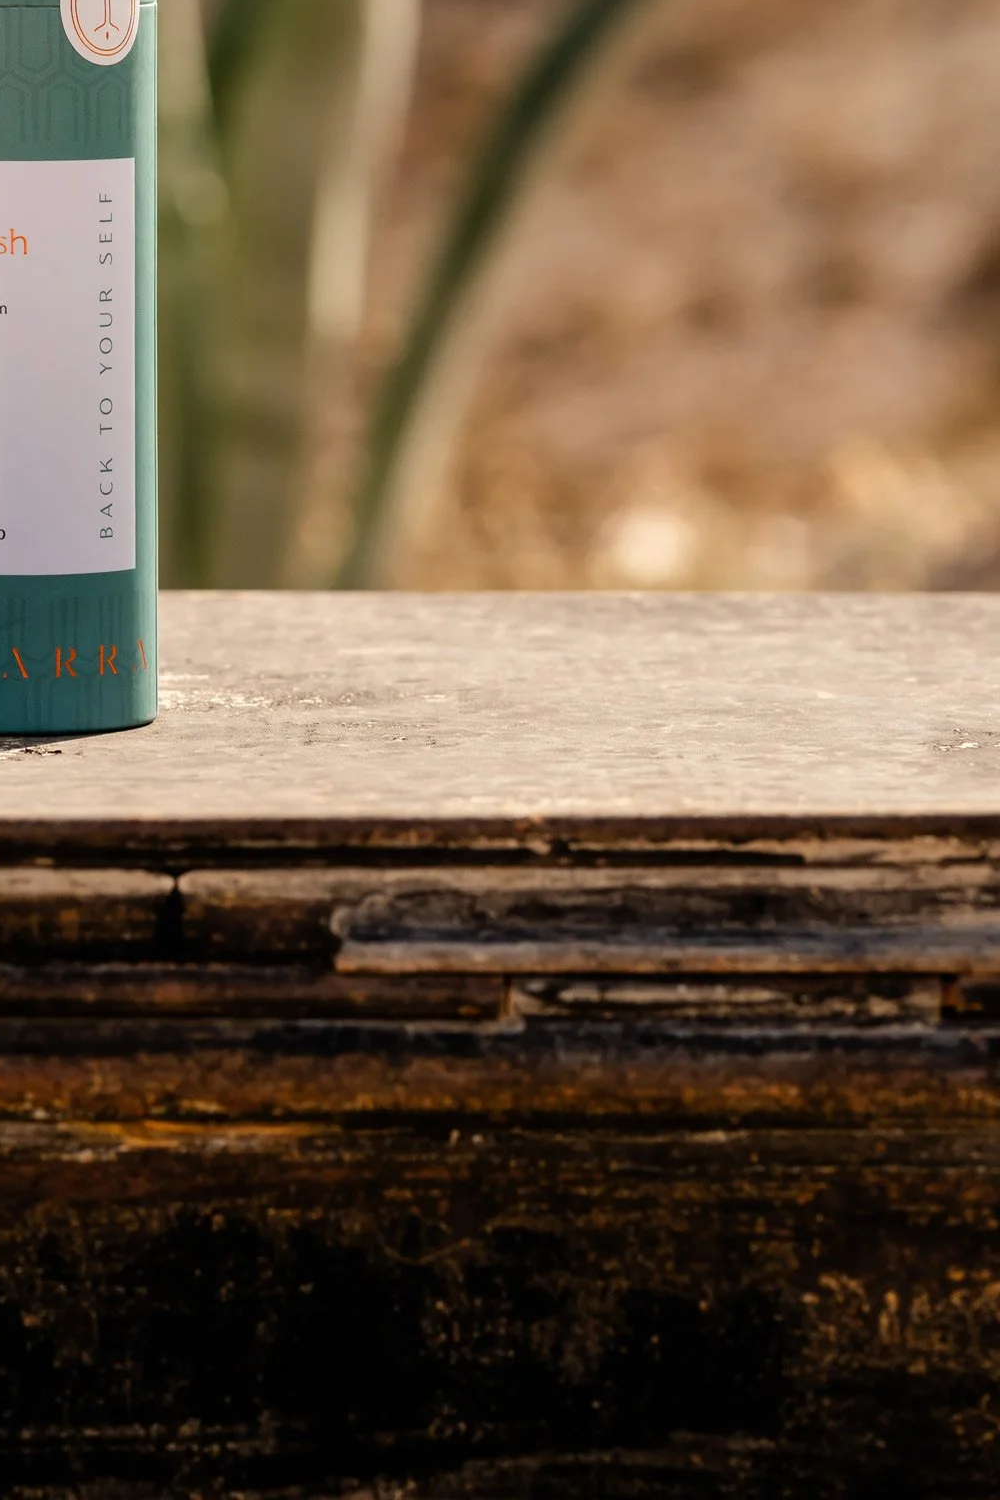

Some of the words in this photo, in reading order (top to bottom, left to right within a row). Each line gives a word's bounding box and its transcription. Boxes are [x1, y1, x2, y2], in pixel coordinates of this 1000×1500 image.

[97, 192, 114, 266] SELF
[97, 287, 114, 376] YOUR
[98, 397, 114, 436] TO
[98, 457, 115, 540] BACK
